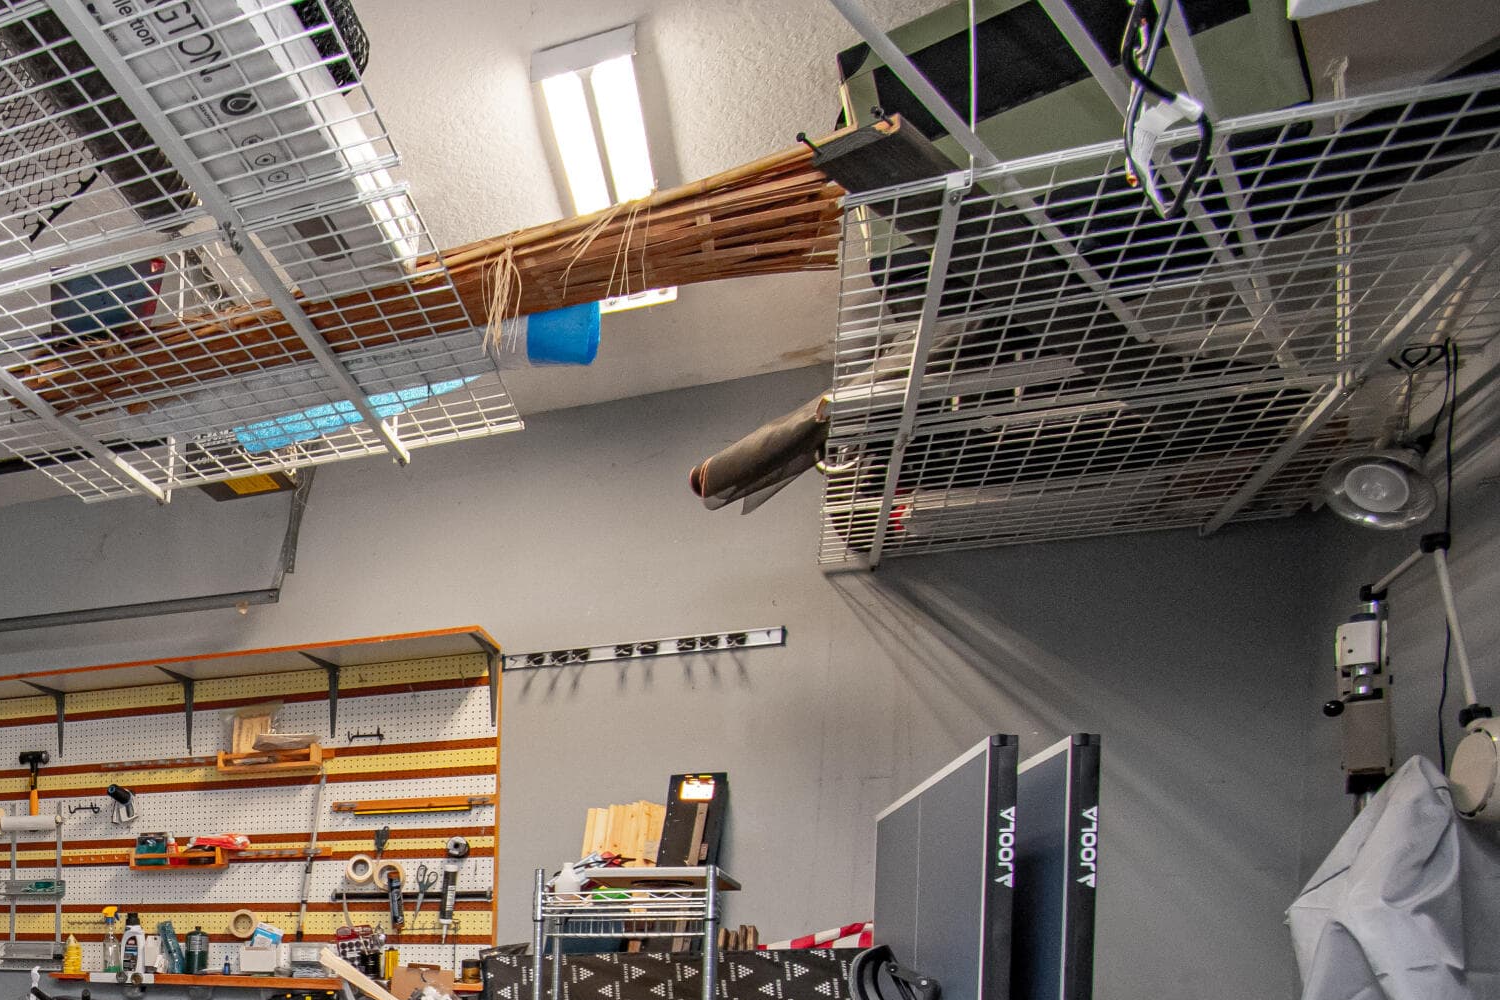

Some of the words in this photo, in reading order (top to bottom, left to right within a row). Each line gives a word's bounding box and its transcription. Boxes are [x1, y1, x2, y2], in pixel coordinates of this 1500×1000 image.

[145, 0, 231, 77] GTON
[998, 806, 1017, 871] JOOLA
[1080, 806, 1098, 871] JOOLA
